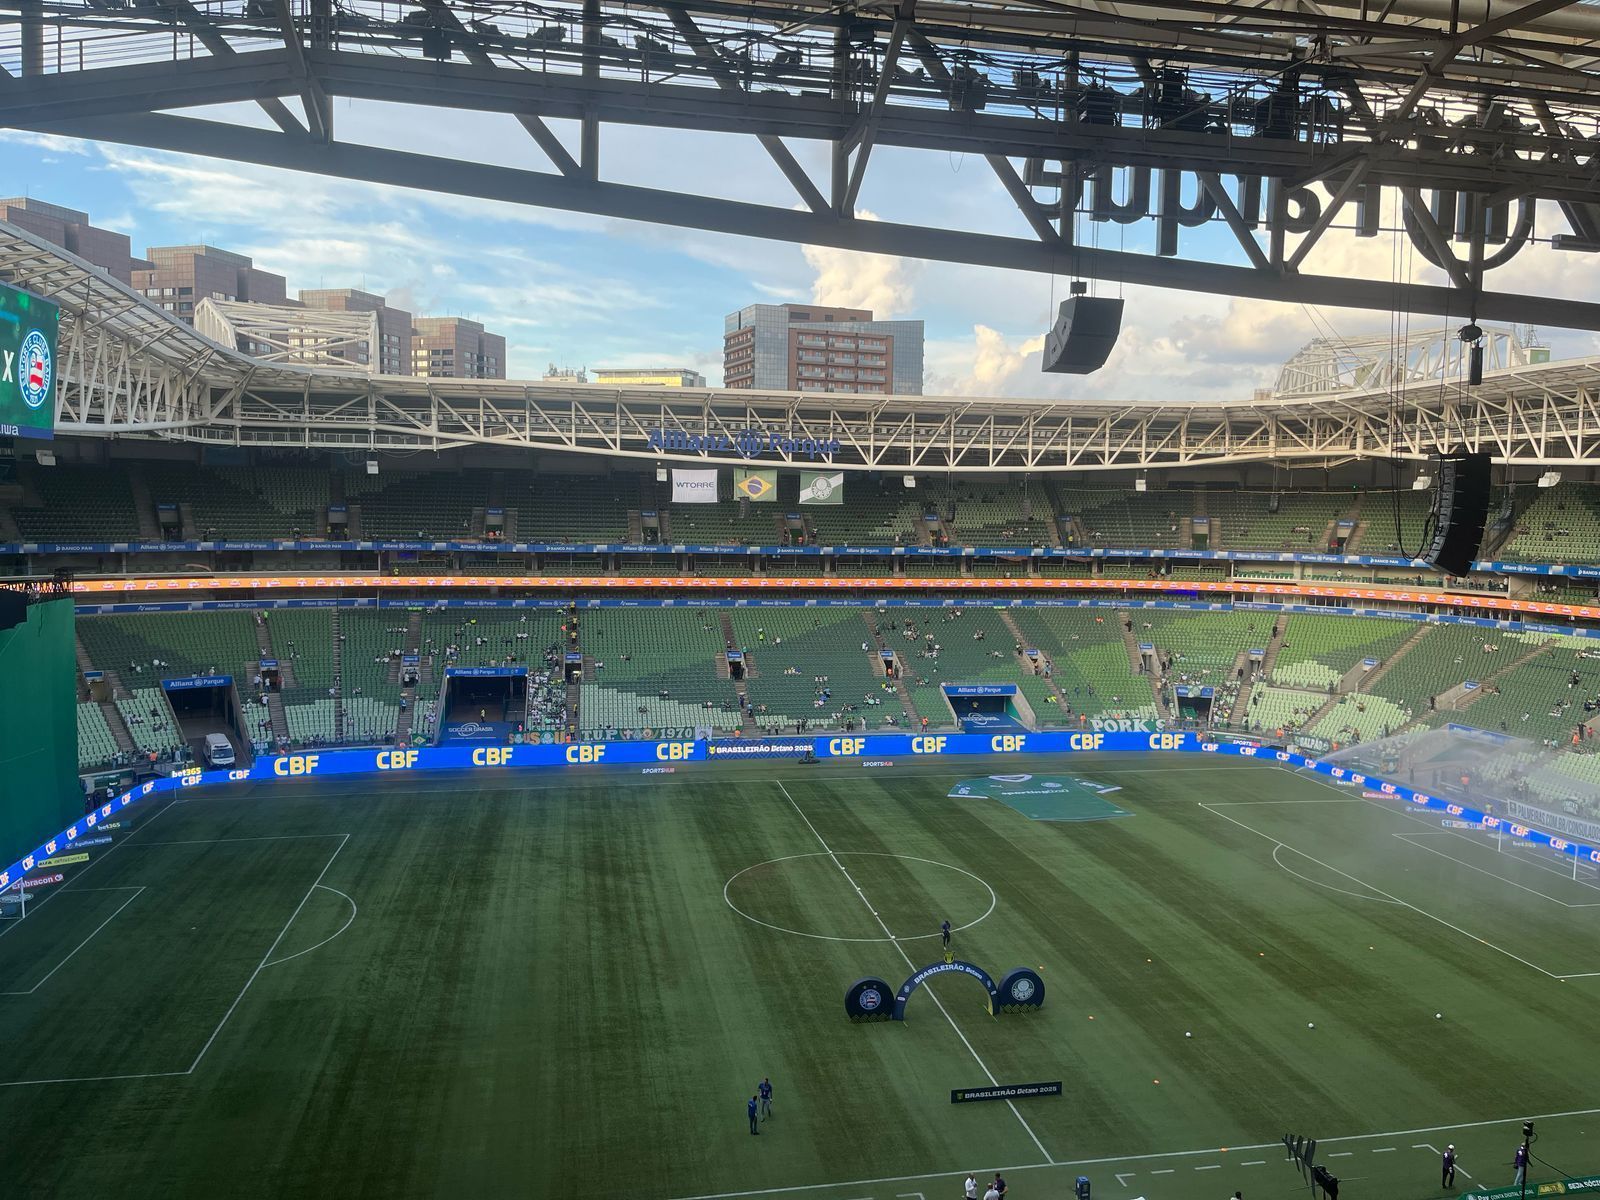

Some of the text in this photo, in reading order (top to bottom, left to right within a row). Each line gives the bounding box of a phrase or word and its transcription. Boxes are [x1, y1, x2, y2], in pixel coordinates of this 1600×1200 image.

[647, 429, 841, 460] Allianz Parque
[676, 481, 714, 489] WTORRE
[660, 728, 693, 739] 1970
[830, 738, 866, 755] CBF
[912, 737, 947, 753] CBF
[991, 735, 1026, 751] CBF
[1070, 734, 1104, 750] CBF
[1149, 733, 1185, 749] CBF
[1202, 743, 1219, 751] CBF
[566, 745, 606, 763] CBF
[656, 742, 695, 760] CBF
[716, 744, 770, 753] BRASILEIRÃO
[1240, 746, 1257, 756] CBF
[376, 750, 419, 769] CBF
[472, 747, 513, 766] CBF
[1276, 752, 1290, 761] CBF
[274, 756, 319, 776] CBF
[1331, 767, 1344, 777] CBF
[172, 767, 201, 778] bet365
[229, 770, 250, 780] CBF
[182, 775, 202, 786] CBF
[1352, 774, 1365, 784] CBF
[143, 782, 154, 794] CBF
[1381, 783, 1396, 794] CBF
[122, 793, 131, 805] CBF
[1413, 793, 1429, 805] CBF
[102, 804, 111, 817] CBF
[1447, 804, 1464, 816] CBF
[87, 813, 96, 827] CBF
[1482, 816, 1500, 828] CBF
[67, 826, 77, 840] CBF
[1510, 825, 1528, 837] CBF
[46, 840, 56, 855] CBF
[1550, 837, 1568, 850] CBF
[22, 855, 34, 871] CBF
[914, 963, 983, 984] BRASILEIRÃO Betano
[965, 1089, 1016, 1099] BRASILEIRÃO
